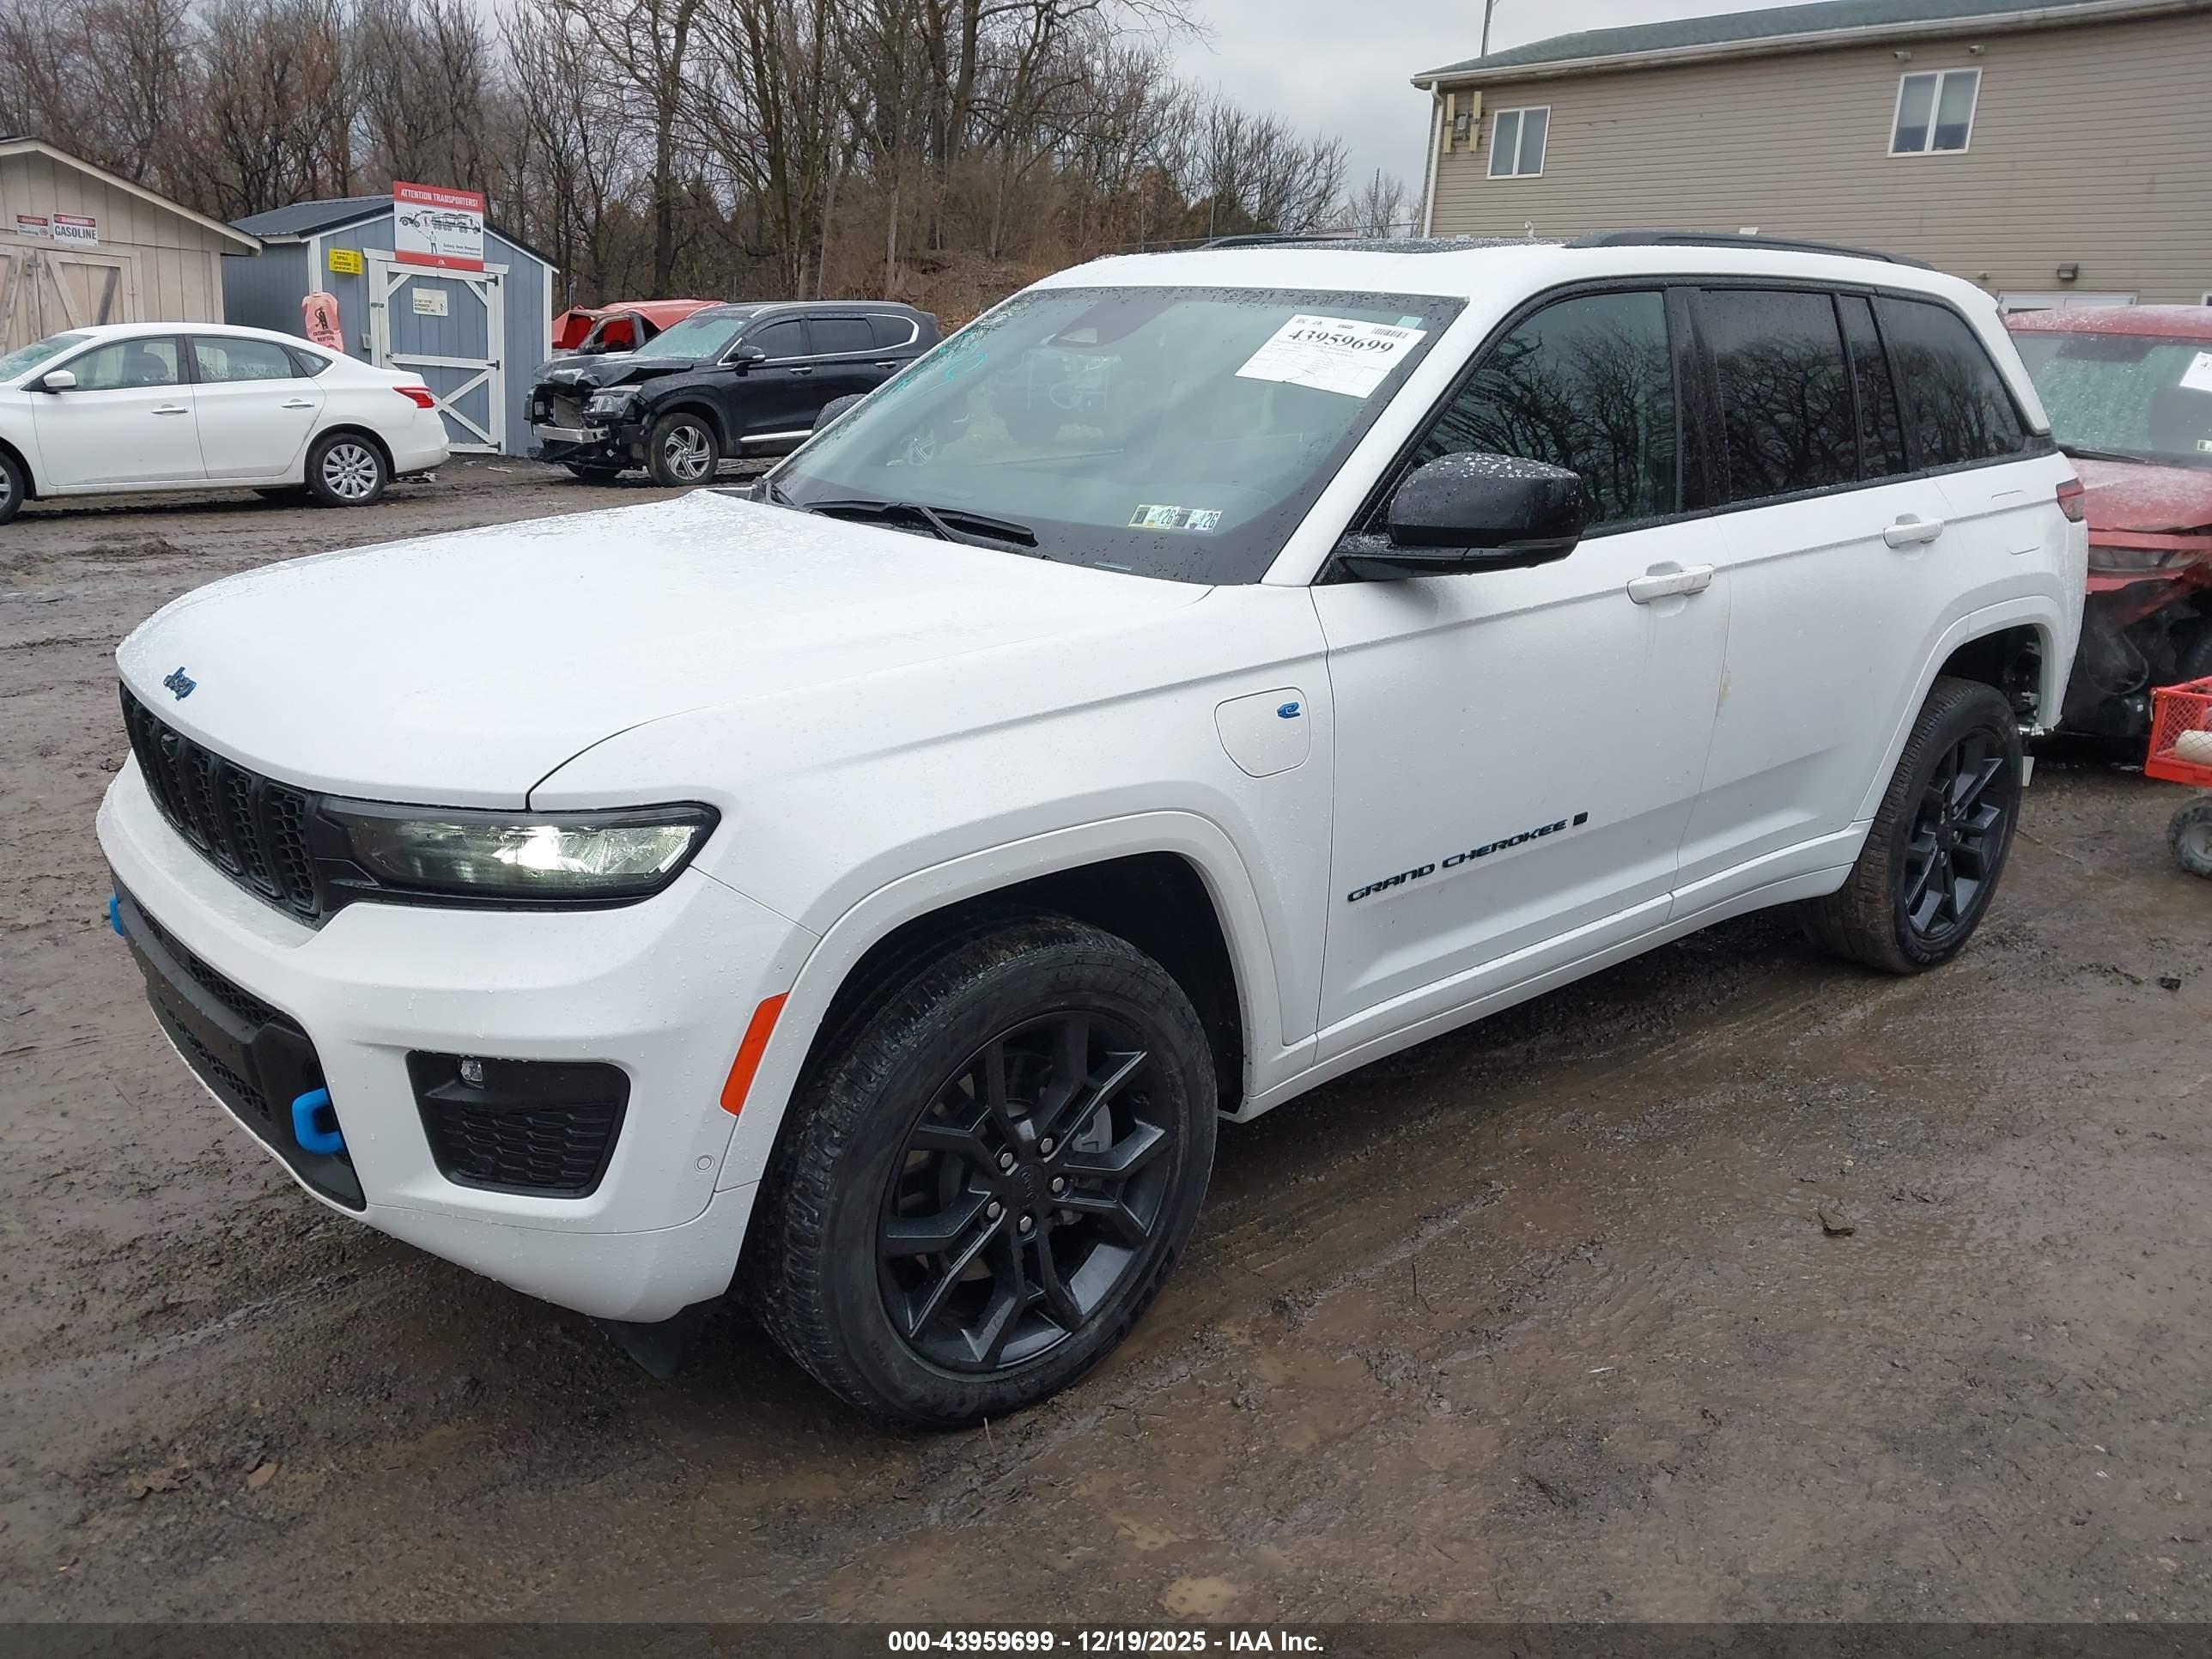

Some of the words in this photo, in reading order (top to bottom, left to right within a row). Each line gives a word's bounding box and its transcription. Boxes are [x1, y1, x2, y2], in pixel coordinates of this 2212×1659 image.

[400, 188, 433, 201] ATTENTION
[434, 193, 478, 207] TRANSPORTERS!
[55, 226, 96, 240] GASOLINE
[1288, 329, 1395, 354] 43959699
[1202, 513, 1219, 529] 26
[1347, 863, 1436, 902] GRAND
[1442, 818, 1568, 868] CHEROKEE
